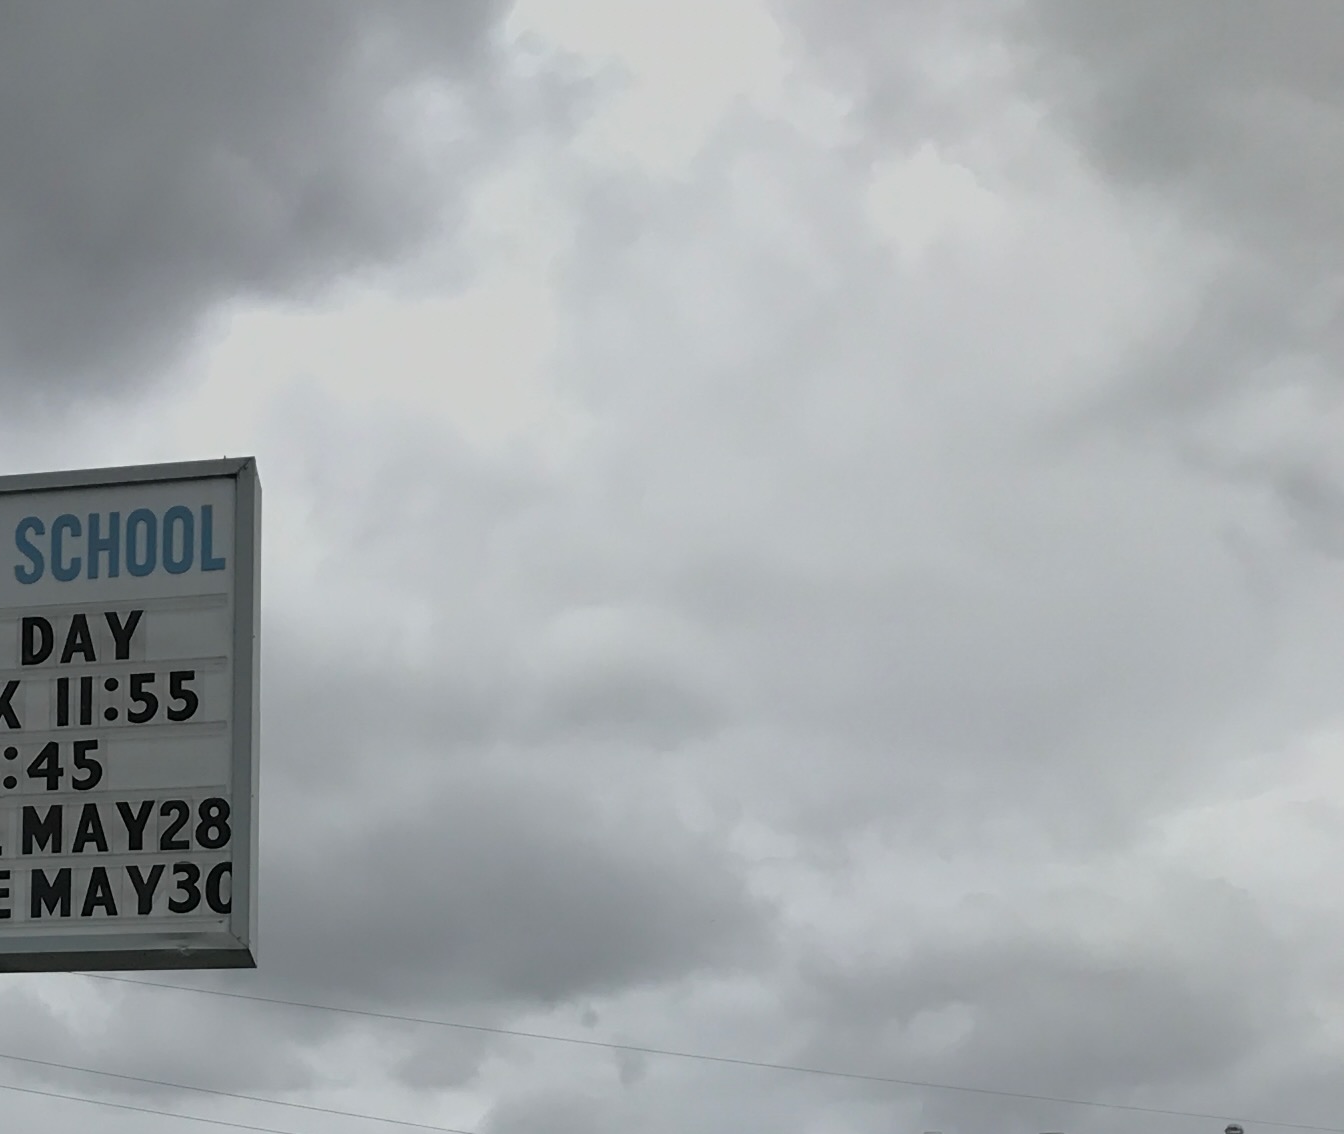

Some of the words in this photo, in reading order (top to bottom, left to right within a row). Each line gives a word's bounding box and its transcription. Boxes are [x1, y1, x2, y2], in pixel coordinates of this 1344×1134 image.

[14, 504, 226, 585] SCHOOL
[21, 609, 144, 667] DAY
[56, 670, 200, 728] 11:55
